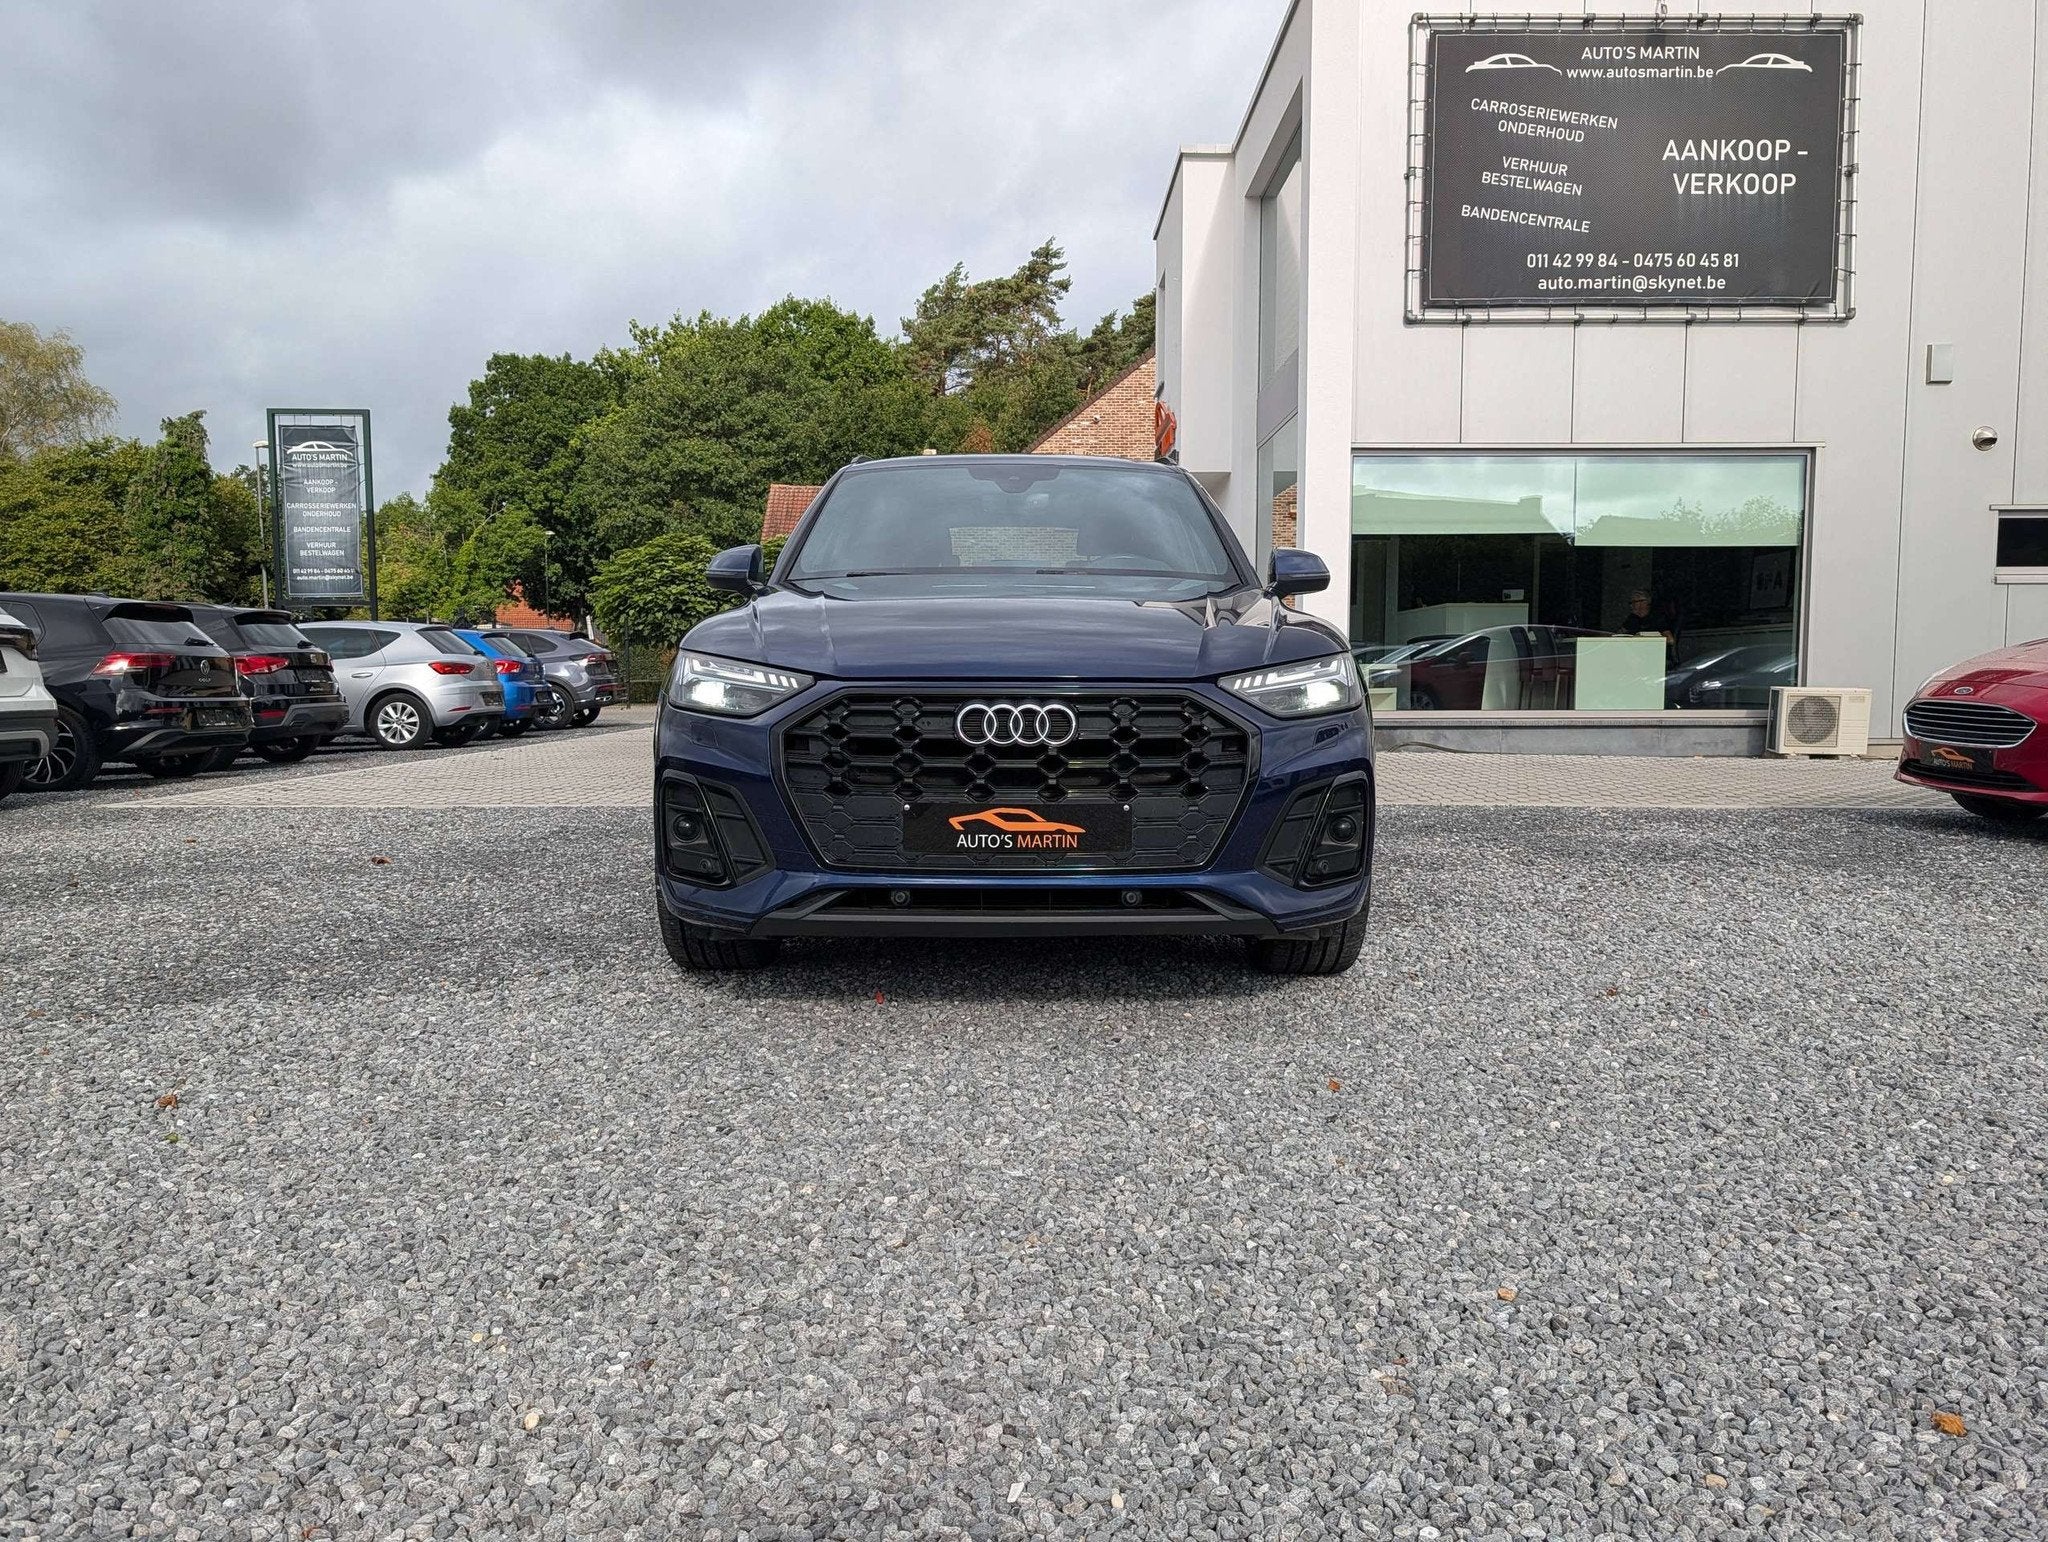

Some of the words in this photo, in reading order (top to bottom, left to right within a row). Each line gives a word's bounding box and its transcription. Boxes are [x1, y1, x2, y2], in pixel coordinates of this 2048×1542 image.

[1580, 45, 1637, 61] AUTO'S
[1639, 45, 1700, 60] MARTIN
[1566, 65, 1715, 79] www.autosmartin.be
[1470, 98, 1618, 129] CARROSERIEWERKEN
[1497, 119, 1585, 143] ONDERHOUD
[1661, 138, 1792, 162] AANKOOP
[1502, 155, 1568, 177] VERHUUR
[1481, 171, 1583, 197] BESTELWAGEN
[1672, 172, 1797, 196] VERKOOP
[1461, 204, 1592, 234] BANDENCENTRALE
[1526, 253, 1549, 268] 011
[1552, 253, 1572, 268] 42
[1575, 253, 1595, 268] 99
[1597, 253, 1618, 268] 84
[1633, 253, 1673, 268] 0475
[1676, 253, 1696, 268] 60
[1699, 253, 1720, 268] 45
[1723, 253, 1739, 268] 81
[1537, 275, 1726, 293] auto.martin@skynet.be
[319, 453, 348, 461] MARTIN
[306, 486, 337, 494] VERKOOP
[299, 549, 345, 557] BESTELWAGEN
[306, 541, 337, 549] VERHUUR
[956, 834, 1013, 848] AUTO'S
[1017, 834, 1078, 848] MARTIN
